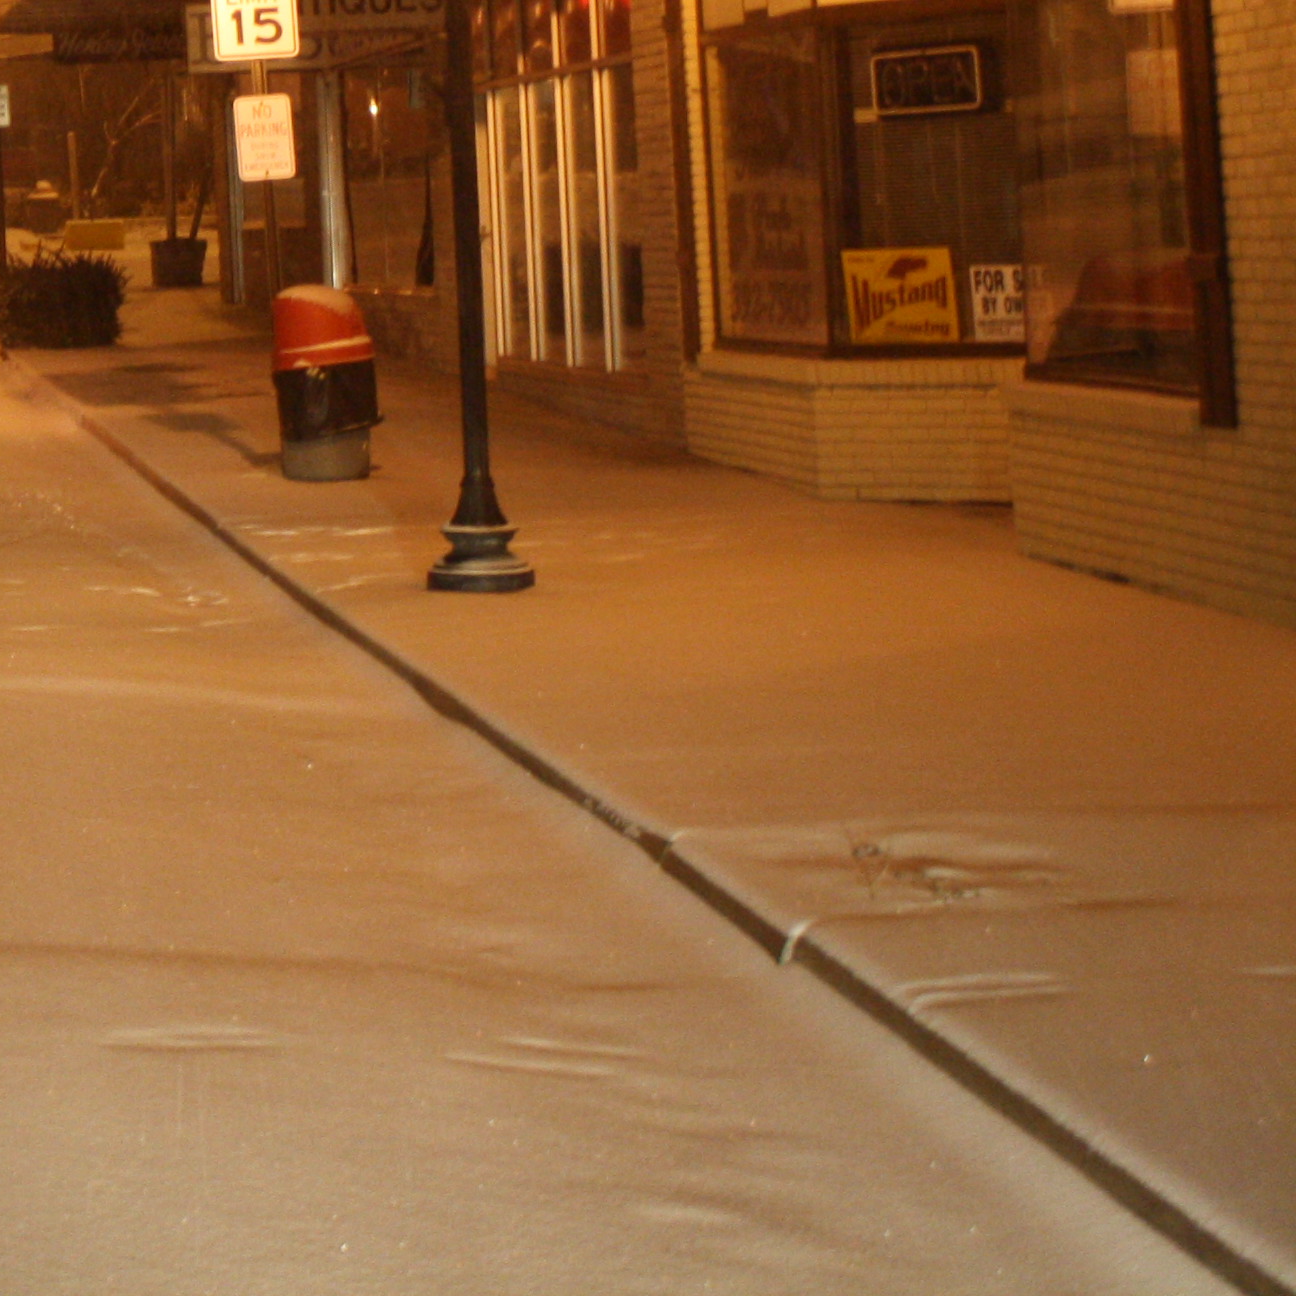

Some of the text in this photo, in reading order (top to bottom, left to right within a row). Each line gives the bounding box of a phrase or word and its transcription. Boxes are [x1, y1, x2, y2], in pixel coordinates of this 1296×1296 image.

[231, 7, 283, 46] 15
[251, 104, 273, 120] NO
[239, 121, 288, 140] PARKING
[973, 269, 1004, 295] FOR
[851, 273, 948, 333] Mustang
[981, 296, 998, 316] BY
